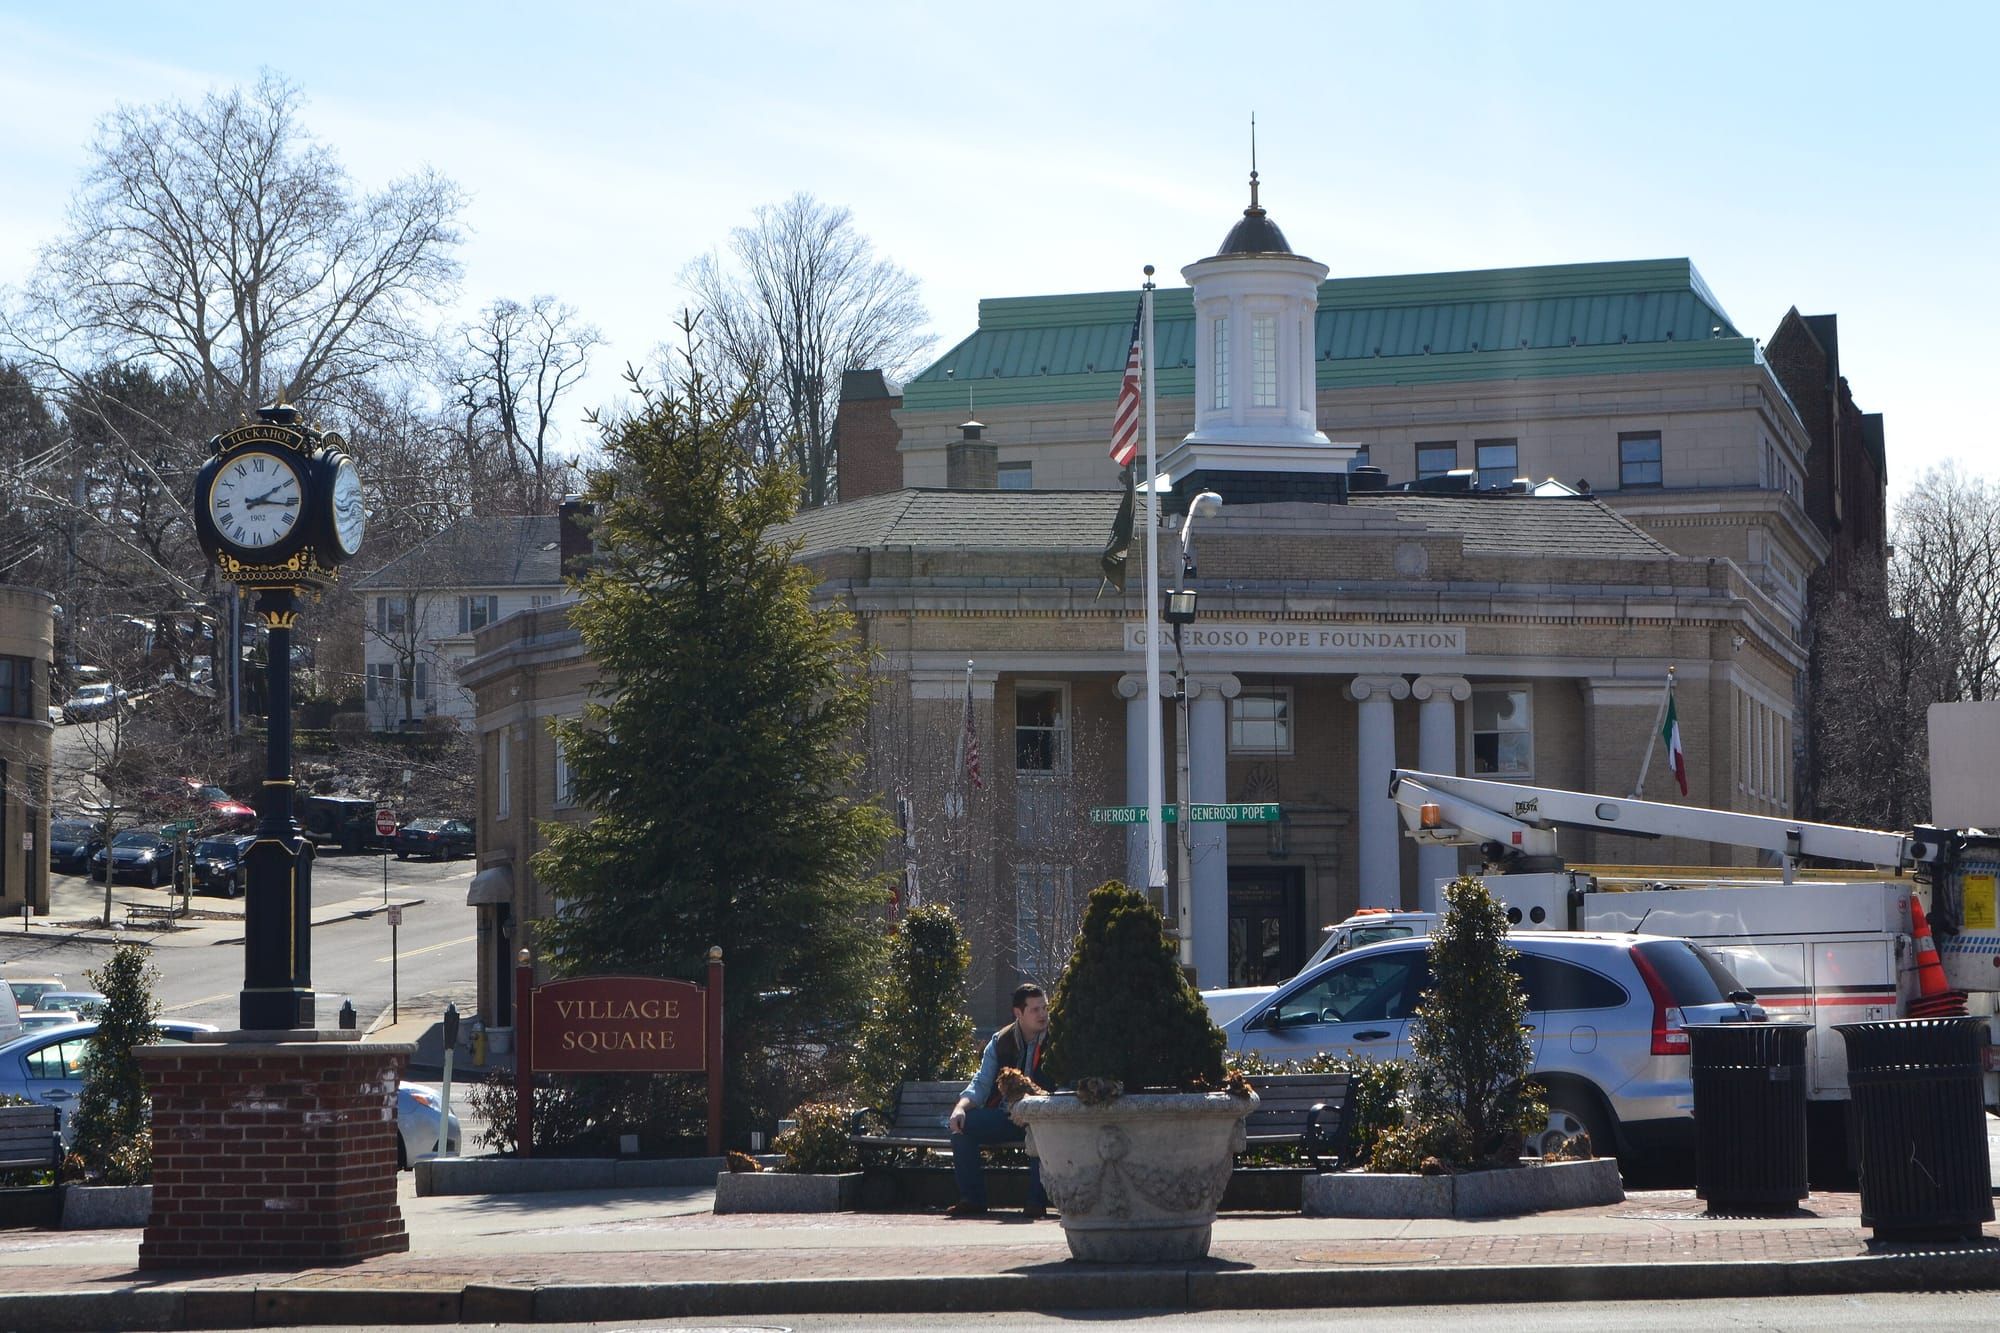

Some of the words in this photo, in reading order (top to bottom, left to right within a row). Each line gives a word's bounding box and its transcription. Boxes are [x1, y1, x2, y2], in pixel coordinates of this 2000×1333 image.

[230, 428, 292, 444] TUCKAHOE
[234, 464, 247, 479] XI
[253, 459, 264, 472] XII
[222, 480, 235, 490] X
[250, 514, 266, 522] 1902
[272, 528, 281, 540] V
[1134, 631, 1249, 646] GNEROSO
[1258, 631, 1309, 646] POPE
[1319, 632, 1457, 648] FOUNDATION
[1191, 807, 1238, 820] GENEROSO
[1242, 806, 1265, 819] POPE
[1515, 801, 1538, 812] TELSTA
[556, 1000, 680, 1019] VILLAGE
[562, 1031, 675, 1053] SQUARE
